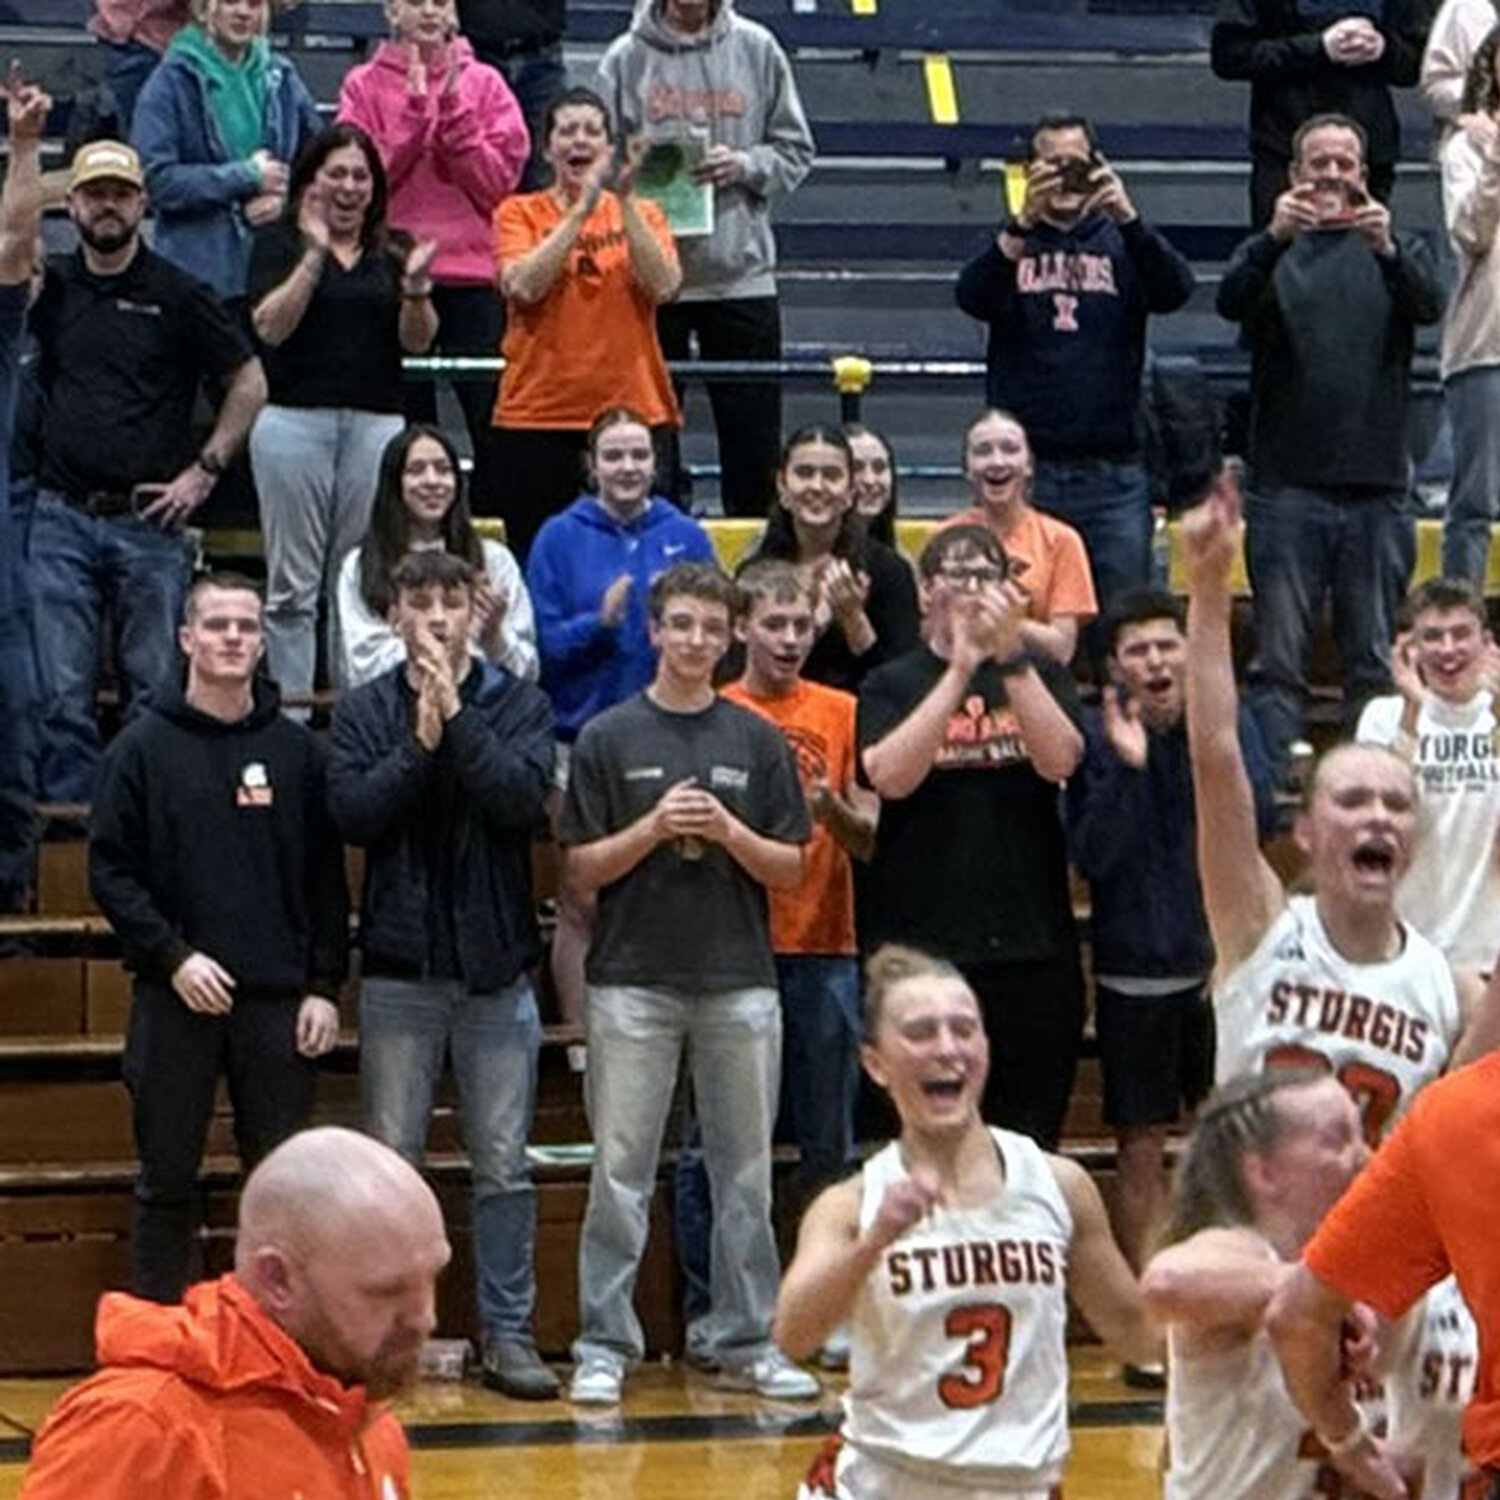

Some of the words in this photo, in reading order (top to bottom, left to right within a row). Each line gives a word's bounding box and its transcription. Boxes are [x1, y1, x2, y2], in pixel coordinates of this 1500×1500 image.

[1420, 733, 1499, 762] TURG
[1267, 979, 1428, 1063] STURGIS
[887, 1238, 1055, 1297] STURGIS
[937, 1301, 1013, 1410] 3
